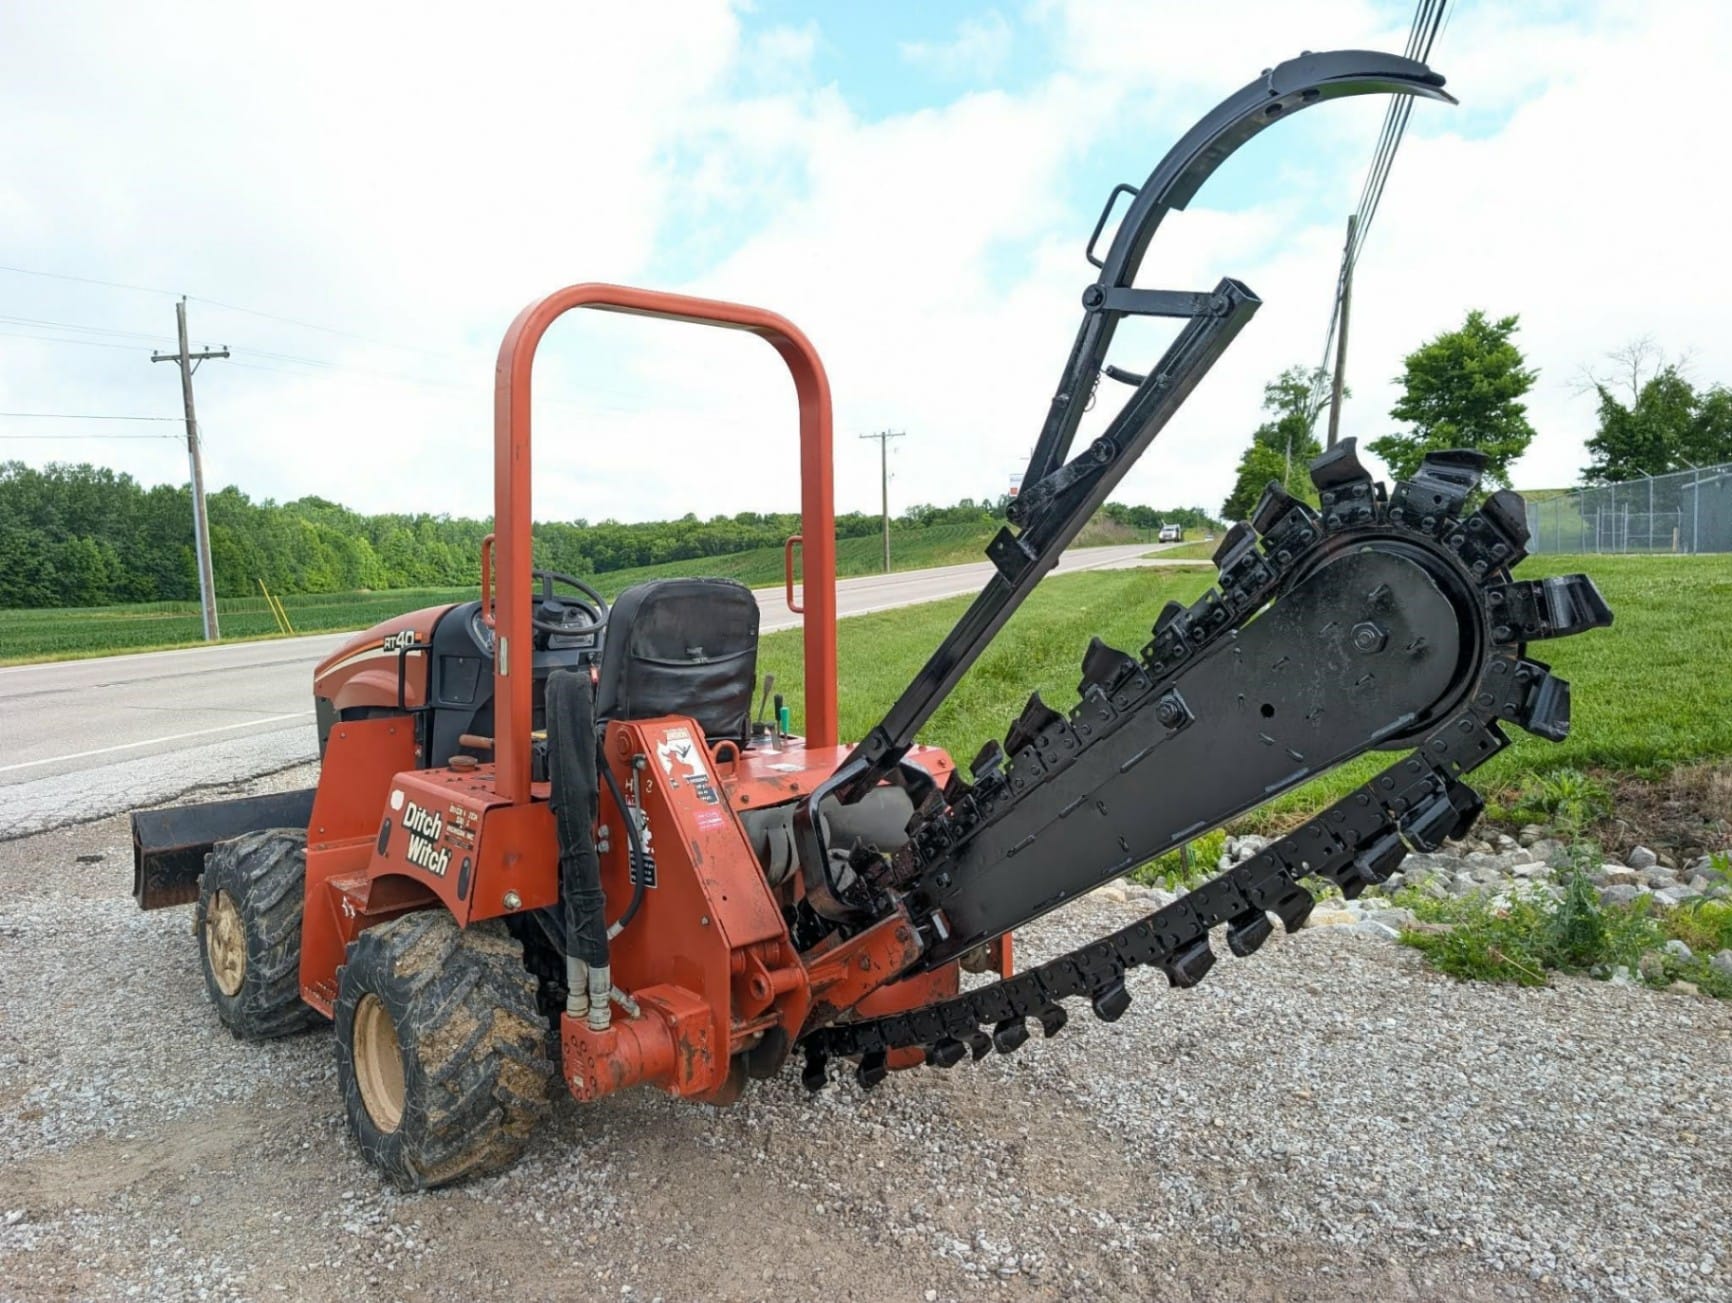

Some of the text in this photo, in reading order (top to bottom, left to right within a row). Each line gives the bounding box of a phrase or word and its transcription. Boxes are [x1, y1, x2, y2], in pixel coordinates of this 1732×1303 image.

[384, 630, 415, 648] RT40
[402, 801, 442, 840] Ditch
[407, 834, 449, 876] Witch
